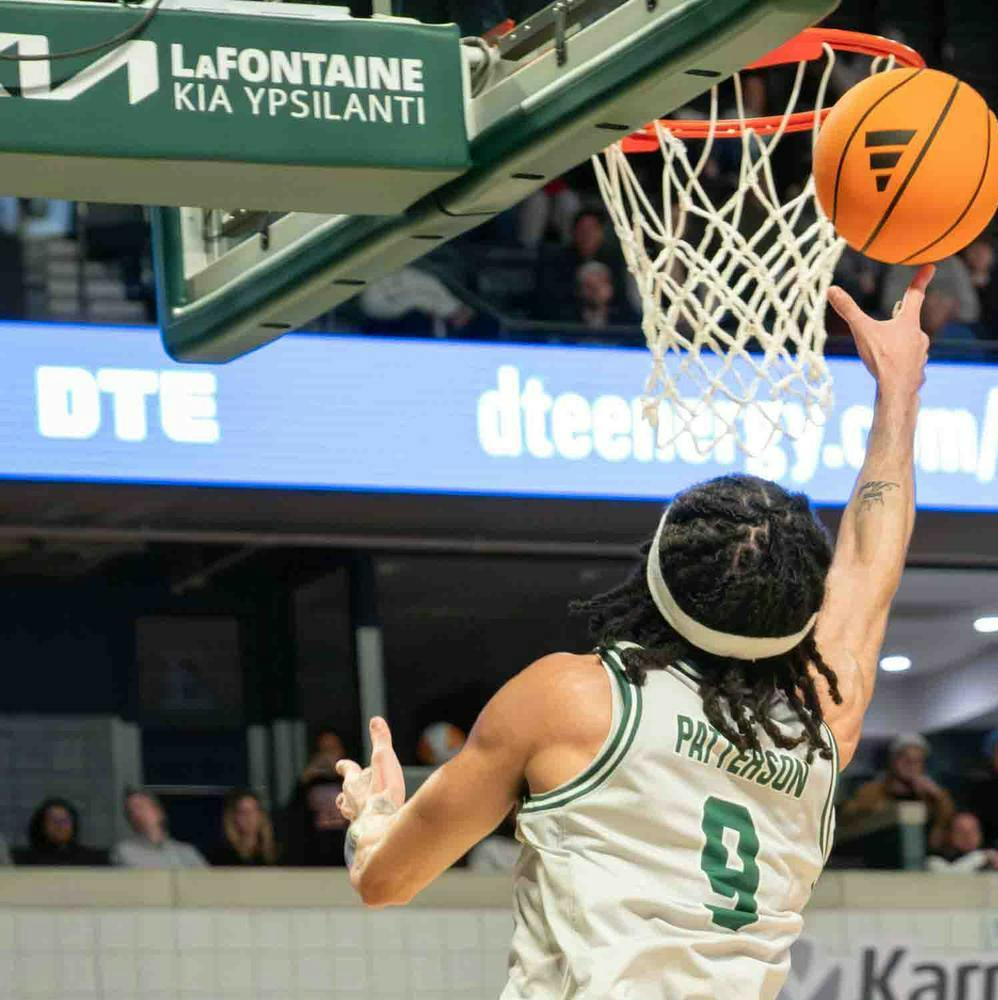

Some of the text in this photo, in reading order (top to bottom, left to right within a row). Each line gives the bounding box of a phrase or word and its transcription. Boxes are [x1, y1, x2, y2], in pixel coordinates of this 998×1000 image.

[173, 82, 426, 125] KIA YPSILANTI
[36, 364, 221, 444] DTE
[701, 795, 759, 932] 9
